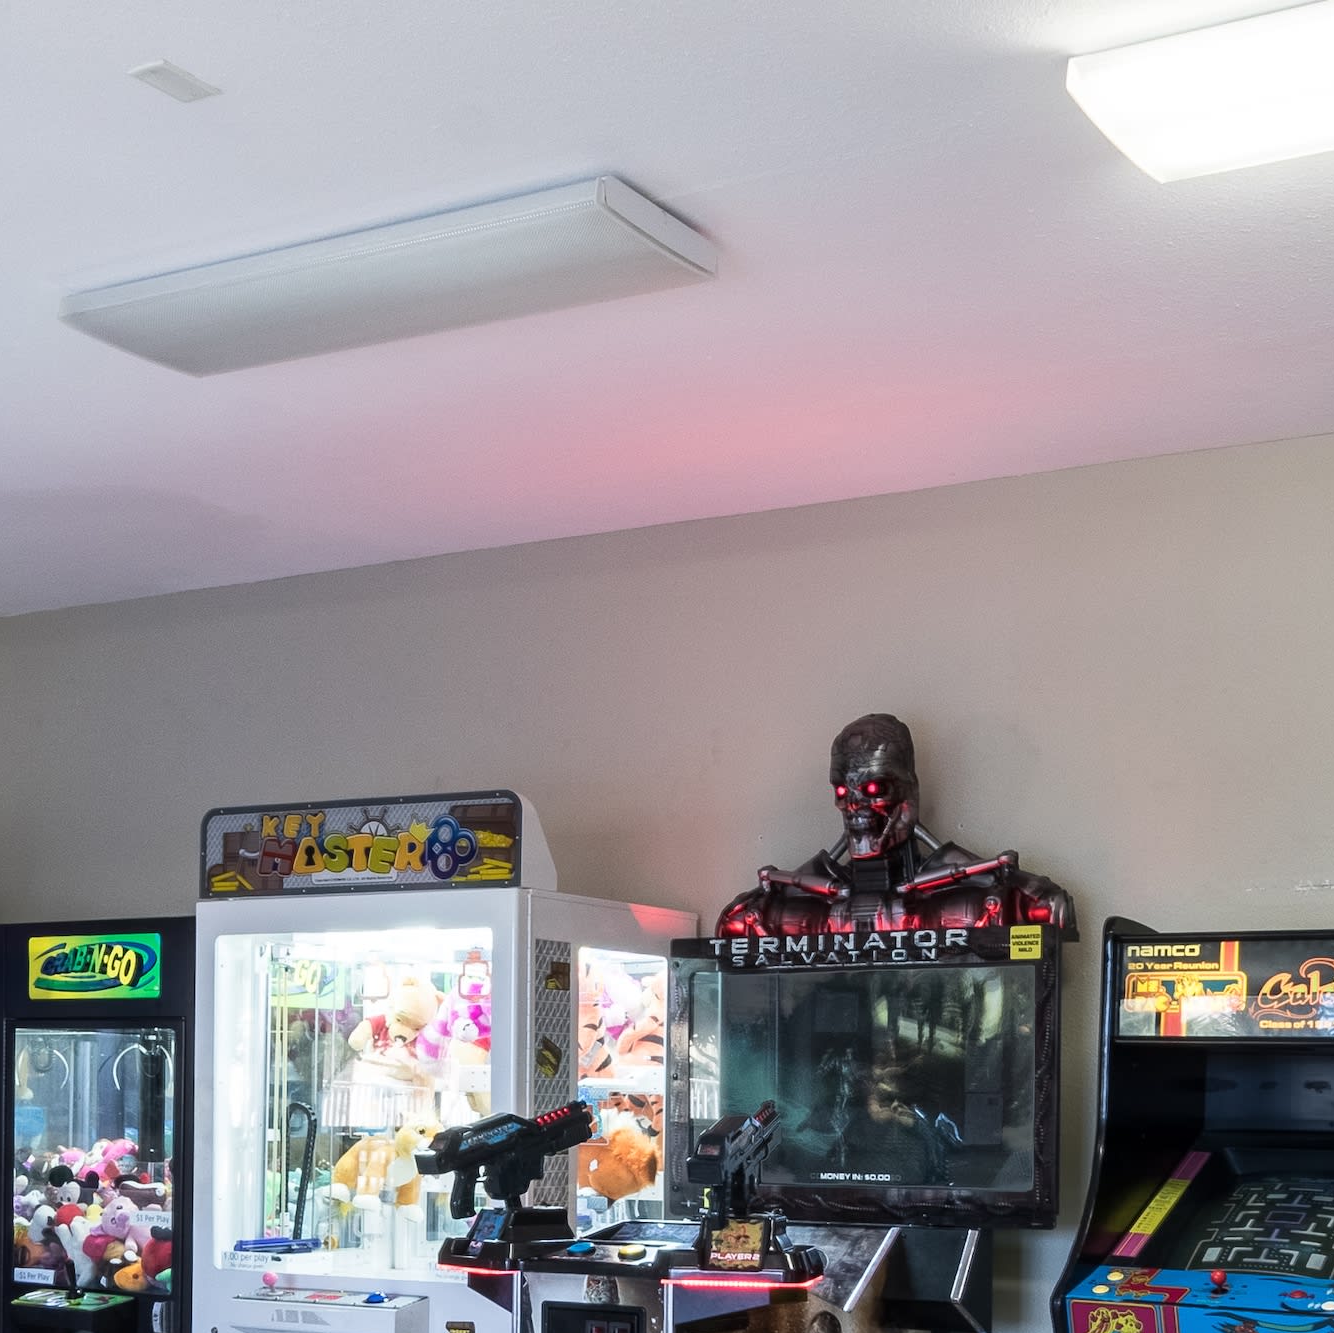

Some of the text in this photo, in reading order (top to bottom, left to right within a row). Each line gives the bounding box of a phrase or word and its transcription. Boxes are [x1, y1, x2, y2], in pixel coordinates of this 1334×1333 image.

[262, 812, 325, 838] KEY
[258, 832, 425, 876] MASTER
[709, 929, 968, 955] TERMINATOR
[1127, 944, 1201, 957] namco
[732, 949, 938, 967] SALVATION
[1128, 961, 1219, 970] 20 Year Reunion
[1259, 1020, 1292, 1029] Class
[1293, 1020, 1307, 1029] of
[820, 1172, 891, 1181] MONEY IN: $0.00
[144, 1214, 157, 1223] Per
[158, 1214, 170, 1225] Play
[224, 1251, 269, 1264] 1.00 per play
[27, 1271, 36, 1280] Per
[37, 1272, 50, 1282] Play
